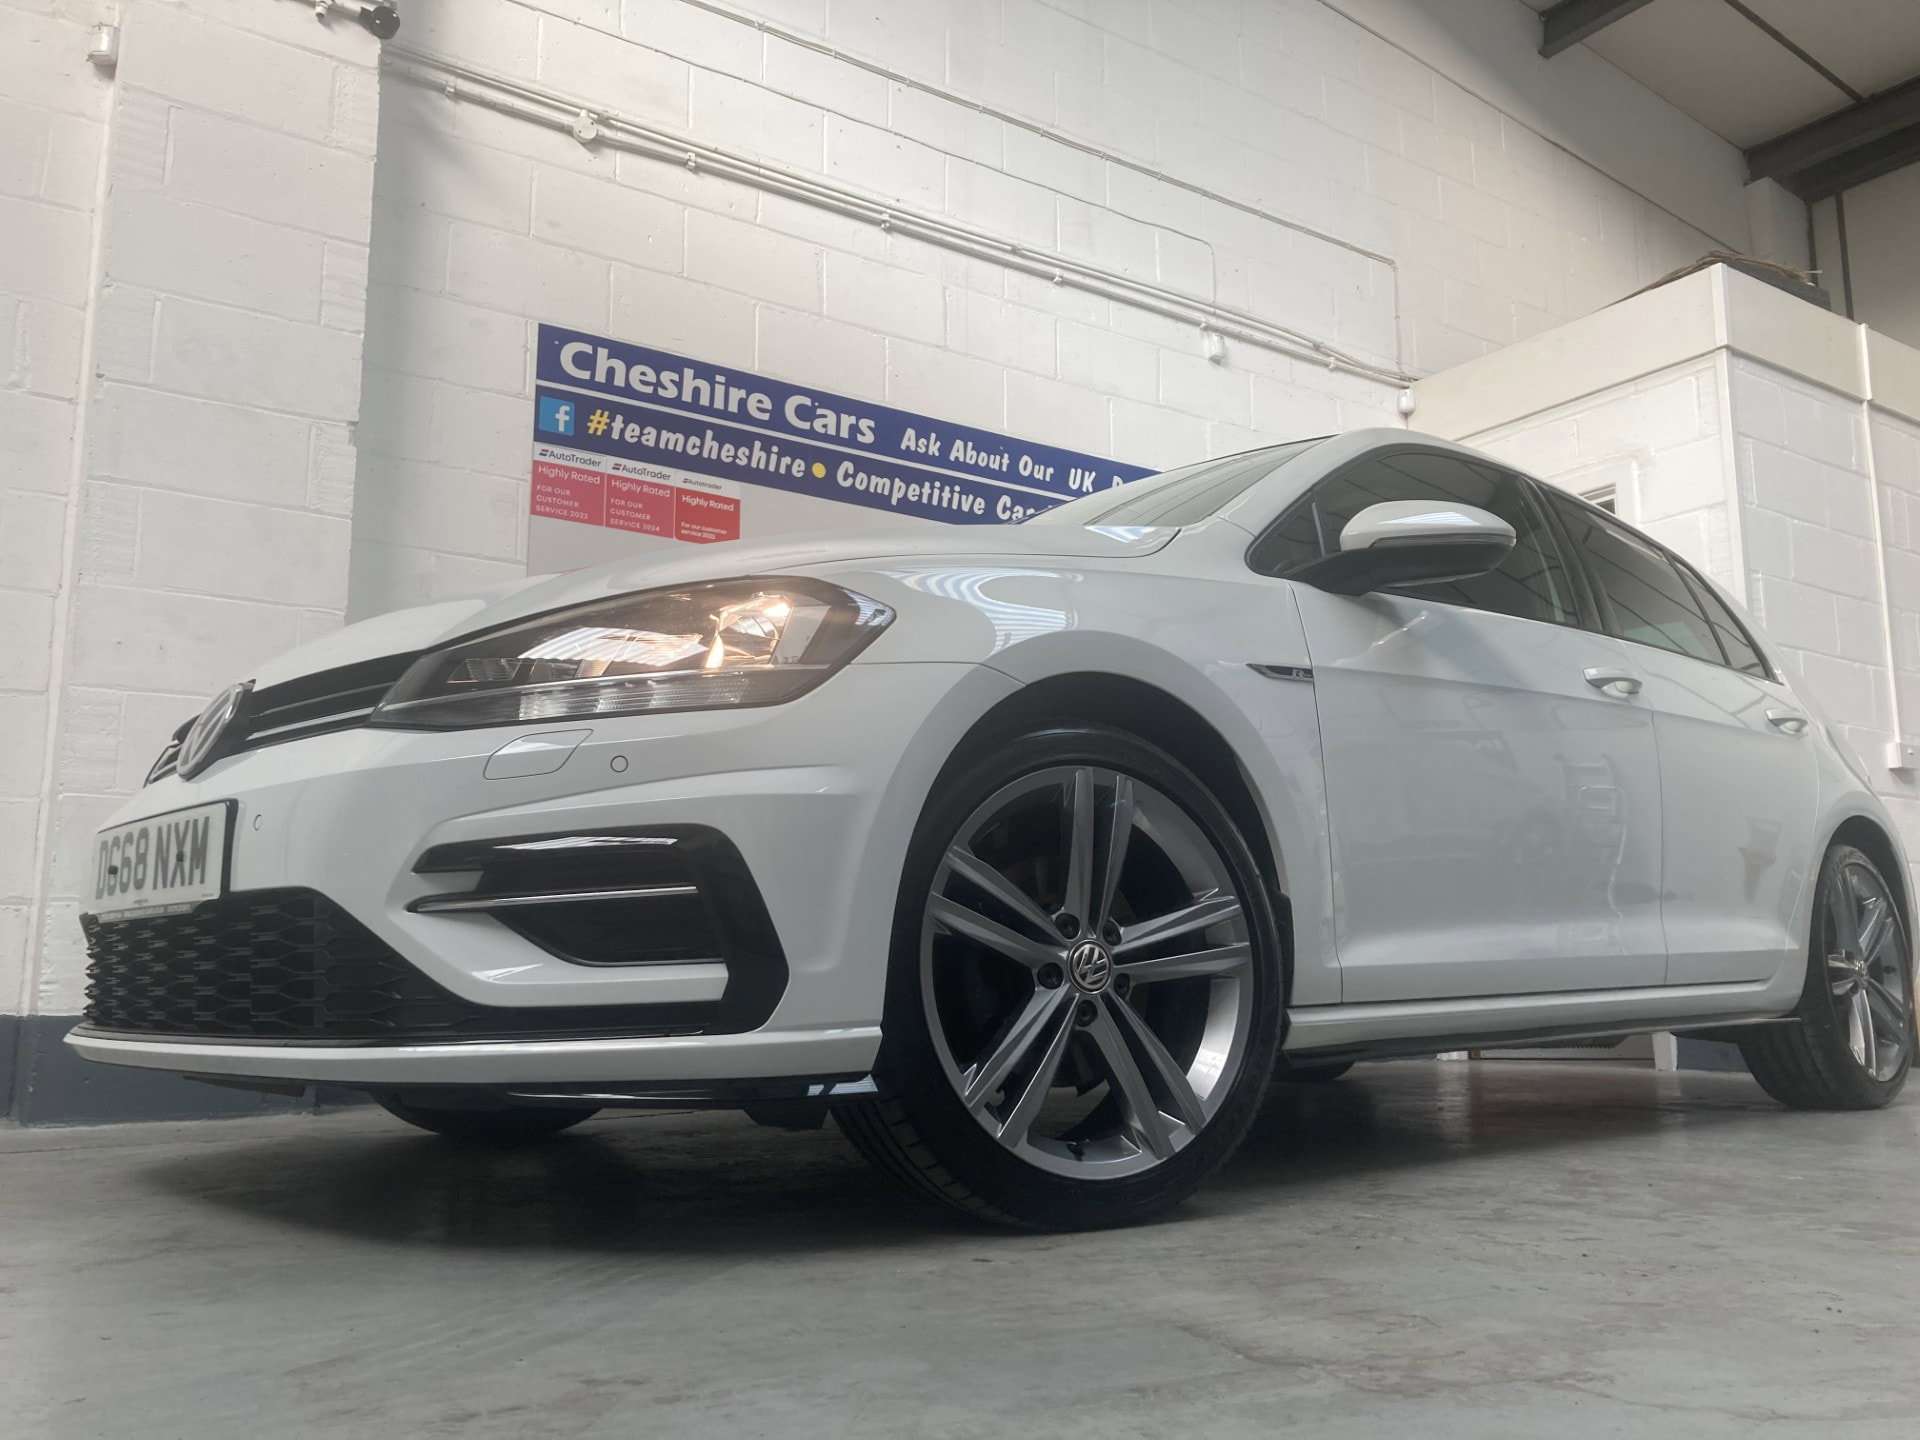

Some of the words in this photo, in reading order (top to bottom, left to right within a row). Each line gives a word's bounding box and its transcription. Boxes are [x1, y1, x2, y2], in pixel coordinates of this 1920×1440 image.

[559, 341, 773, 421] Cheshire
[784, 394, 876, 444] Cars
[549, 450, 601, 468] AutoTrader
[587, 408, 806, 478] #teamcheshire
[836, 461, 986, 516] Competitive
[900, 427, 941, 457] Ask
[949, 439, 1009, 473] About
[1018, 454, 1054, 482] Our
[1068, 467, 1096, 493] UK
[538, 464, 570, 481] Highly
[571, 471, 600, 485] Rated
[621, 465, 672, 481] AutoTrader
[536, 484, 553, 494] FOR
[554, 487, 571, 496] OUR
[611, 479, 642, 494] Highly
[642, 485, 671, 498] Rated
[536, 494, 579, 508] CUSTOMER
[610, 498, 626, 507] FOR
[627, 500, 644, 509] OUR
[681, 494, 708, 508] Highly
[709, 500, 735, 512] Rated
[535, 504, 568, 517] SERVICE
[610, 508, 651, 520] CUSTOMER
[610, 518, 641, 529] SERVICE
[152, 815, 210, 891] NXM
